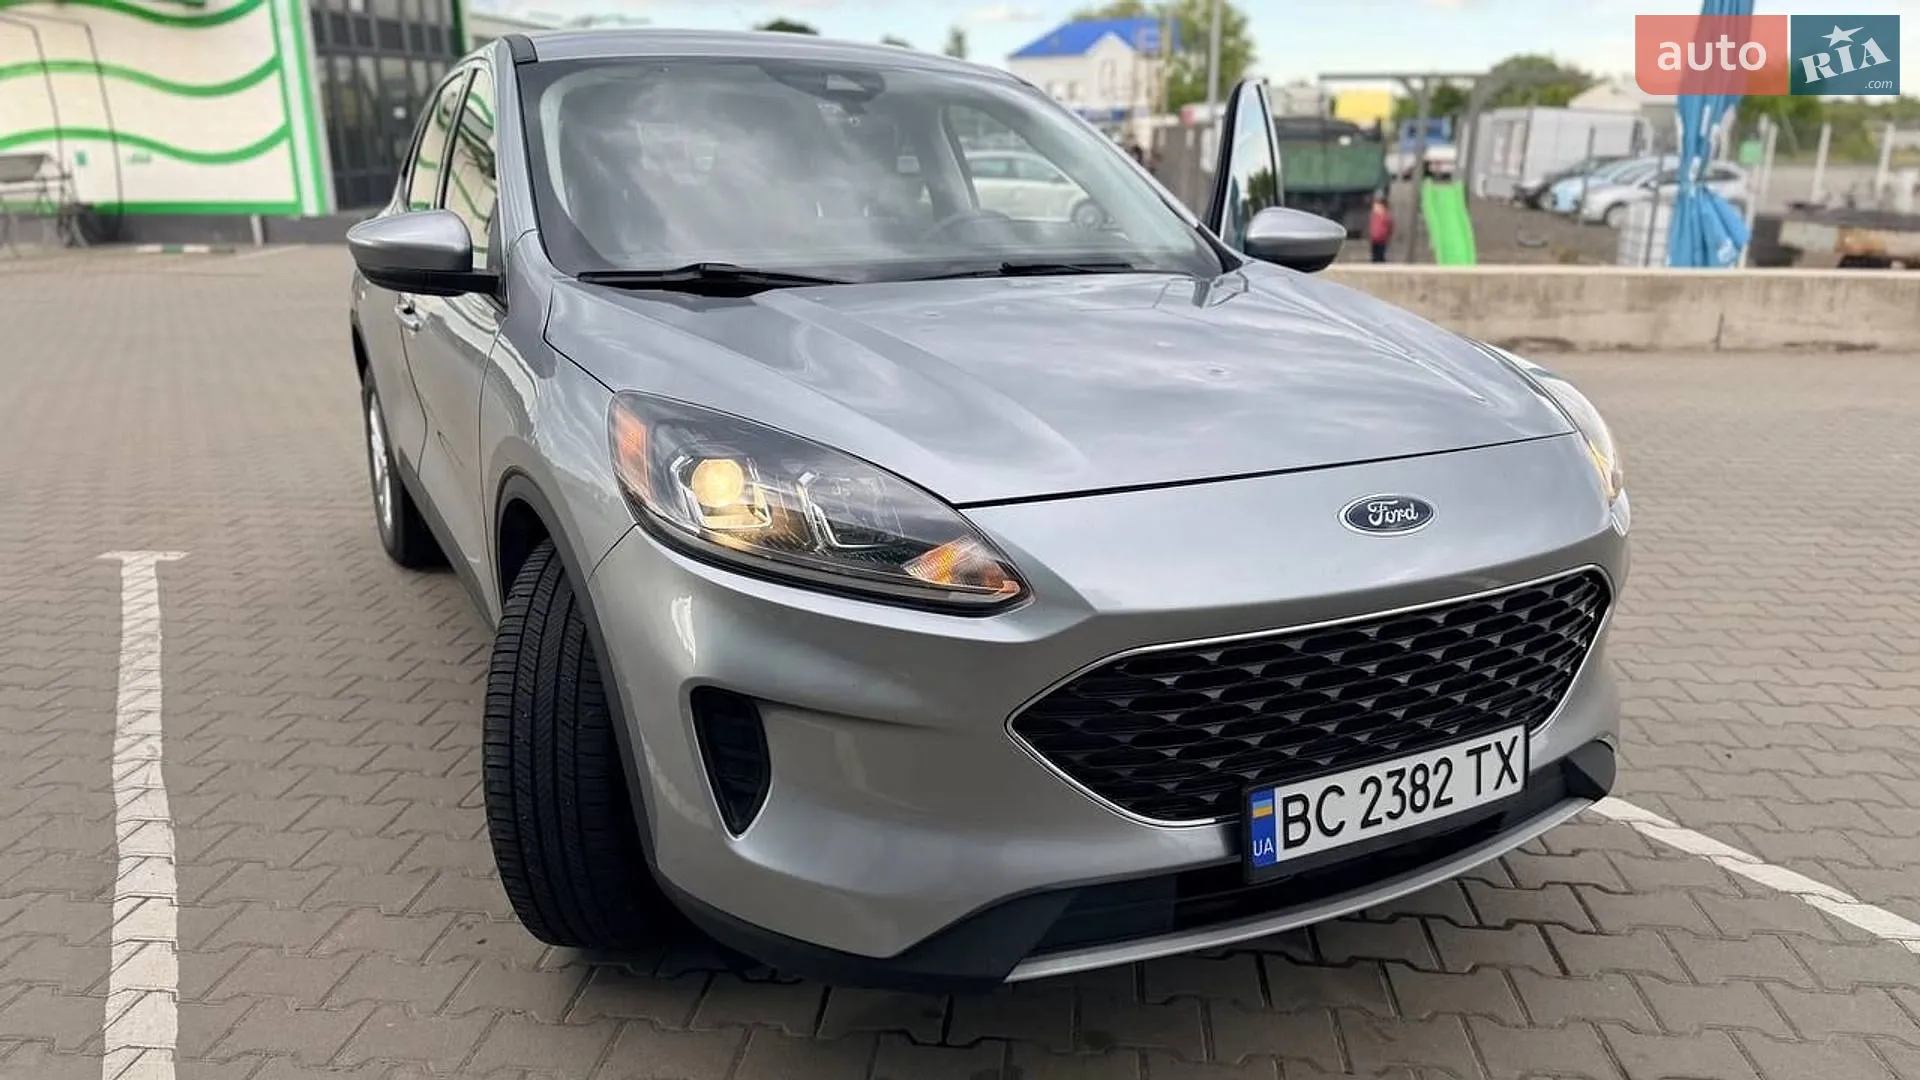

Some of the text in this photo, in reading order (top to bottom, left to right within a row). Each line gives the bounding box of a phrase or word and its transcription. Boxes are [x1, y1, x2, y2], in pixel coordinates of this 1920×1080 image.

[1367, 500, 1419, 526] Ford
[1282, 735, 1519, 850] BC 2382 TX
[1252, 837, 1275, 857] UA
